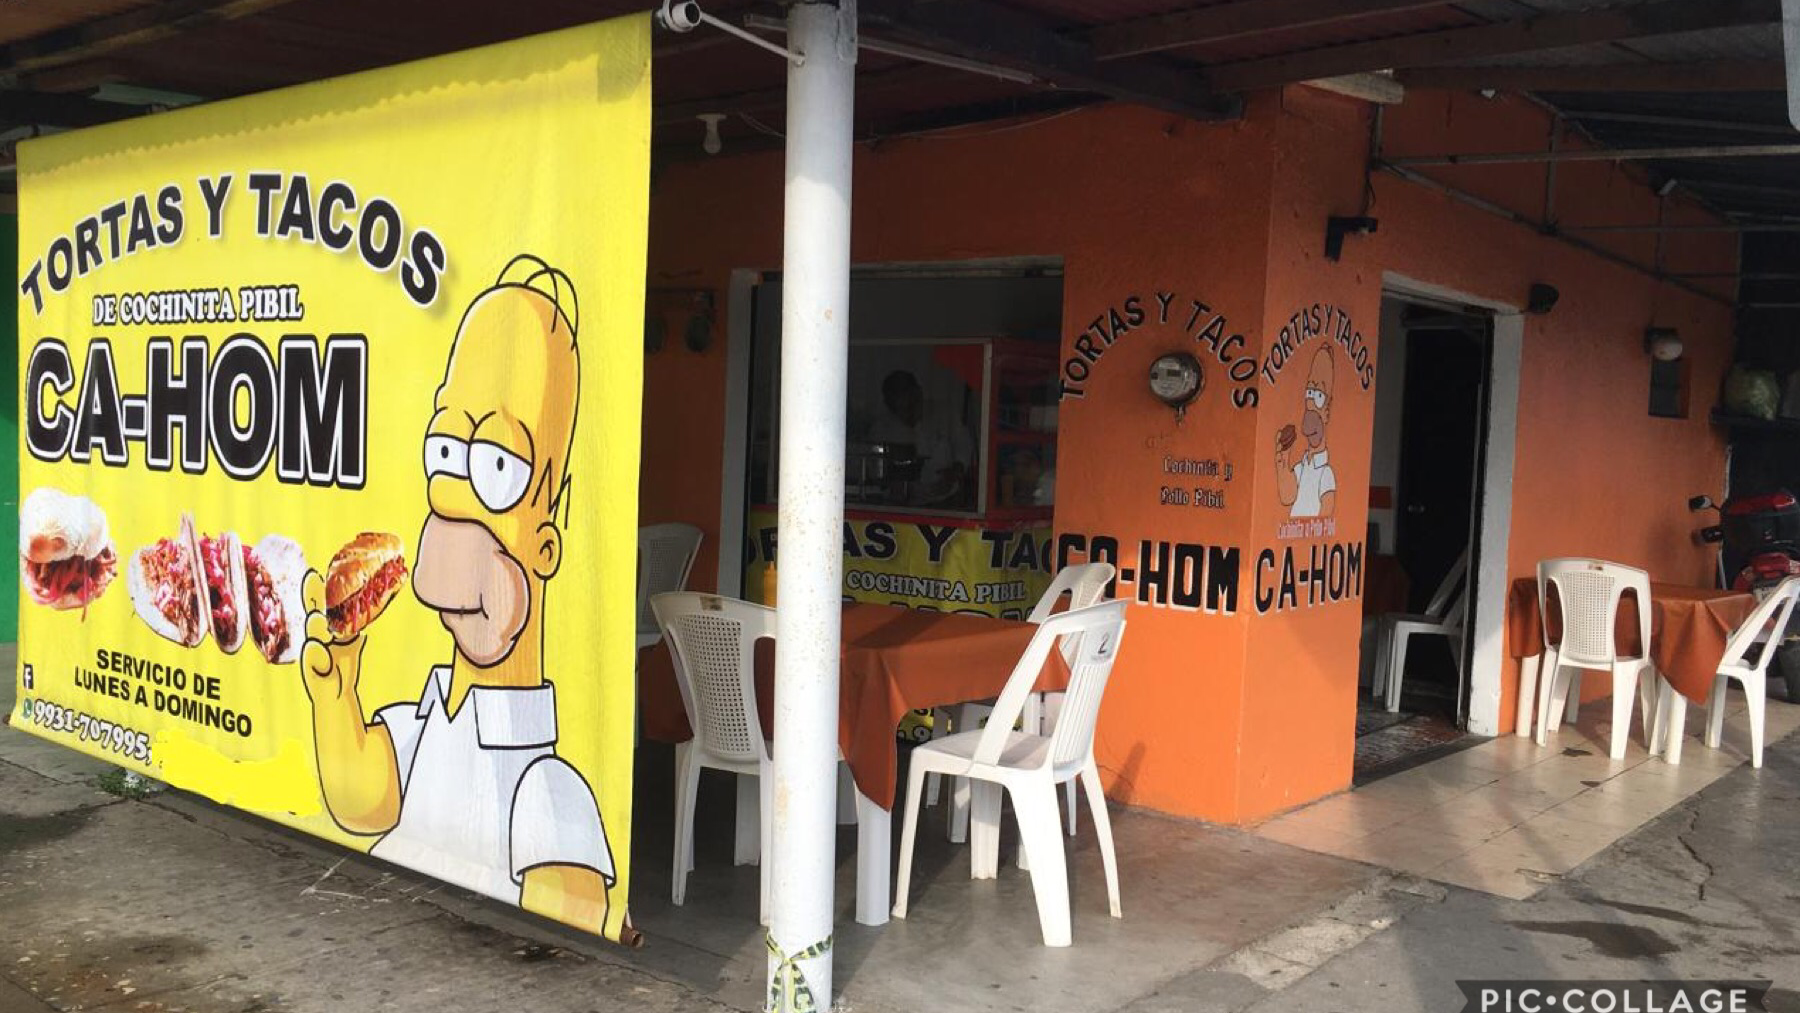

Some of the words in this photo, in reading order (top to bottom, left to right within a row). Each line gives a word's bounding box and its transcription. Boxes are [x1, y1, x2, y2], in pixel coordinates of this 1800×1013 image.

[21, 185, 185, 315] TORTAS
[198, 175, 232, 236] Y
[248, 173, 446, 305] TACOS
[93, 294, 117, 326] DE
[119, 287, 236, 326] COCHINITA
[239, 283, 304, 321] PIBIL
[1059, 296, 1146, 402] TORTAS
[1155, 290, 1176, 323] Y
[1184, 299, 1260, 409] TACOS
[1261, 302, 1322, 387] TORTAS
[1323, 303, 1334, 336] Y
[1335, 308, 1374, 391] TACOS
[25, 333, 368, 491] CA-HOM
[916, 523, 959, 563] Y
[1254, 541, 1362, 615] CA-HOM
[847, 569, 969, 602] COCHINITA
[975, 580, 1026, 604] PIBIL
[74, 666, 130, 701] LUNES
[134, 686, 149, 708] A
[154, 689, 252, 738] DOMINGO
[96, 649, 187, 690] SERVICIO
[194, 673, 221, 700] DE
